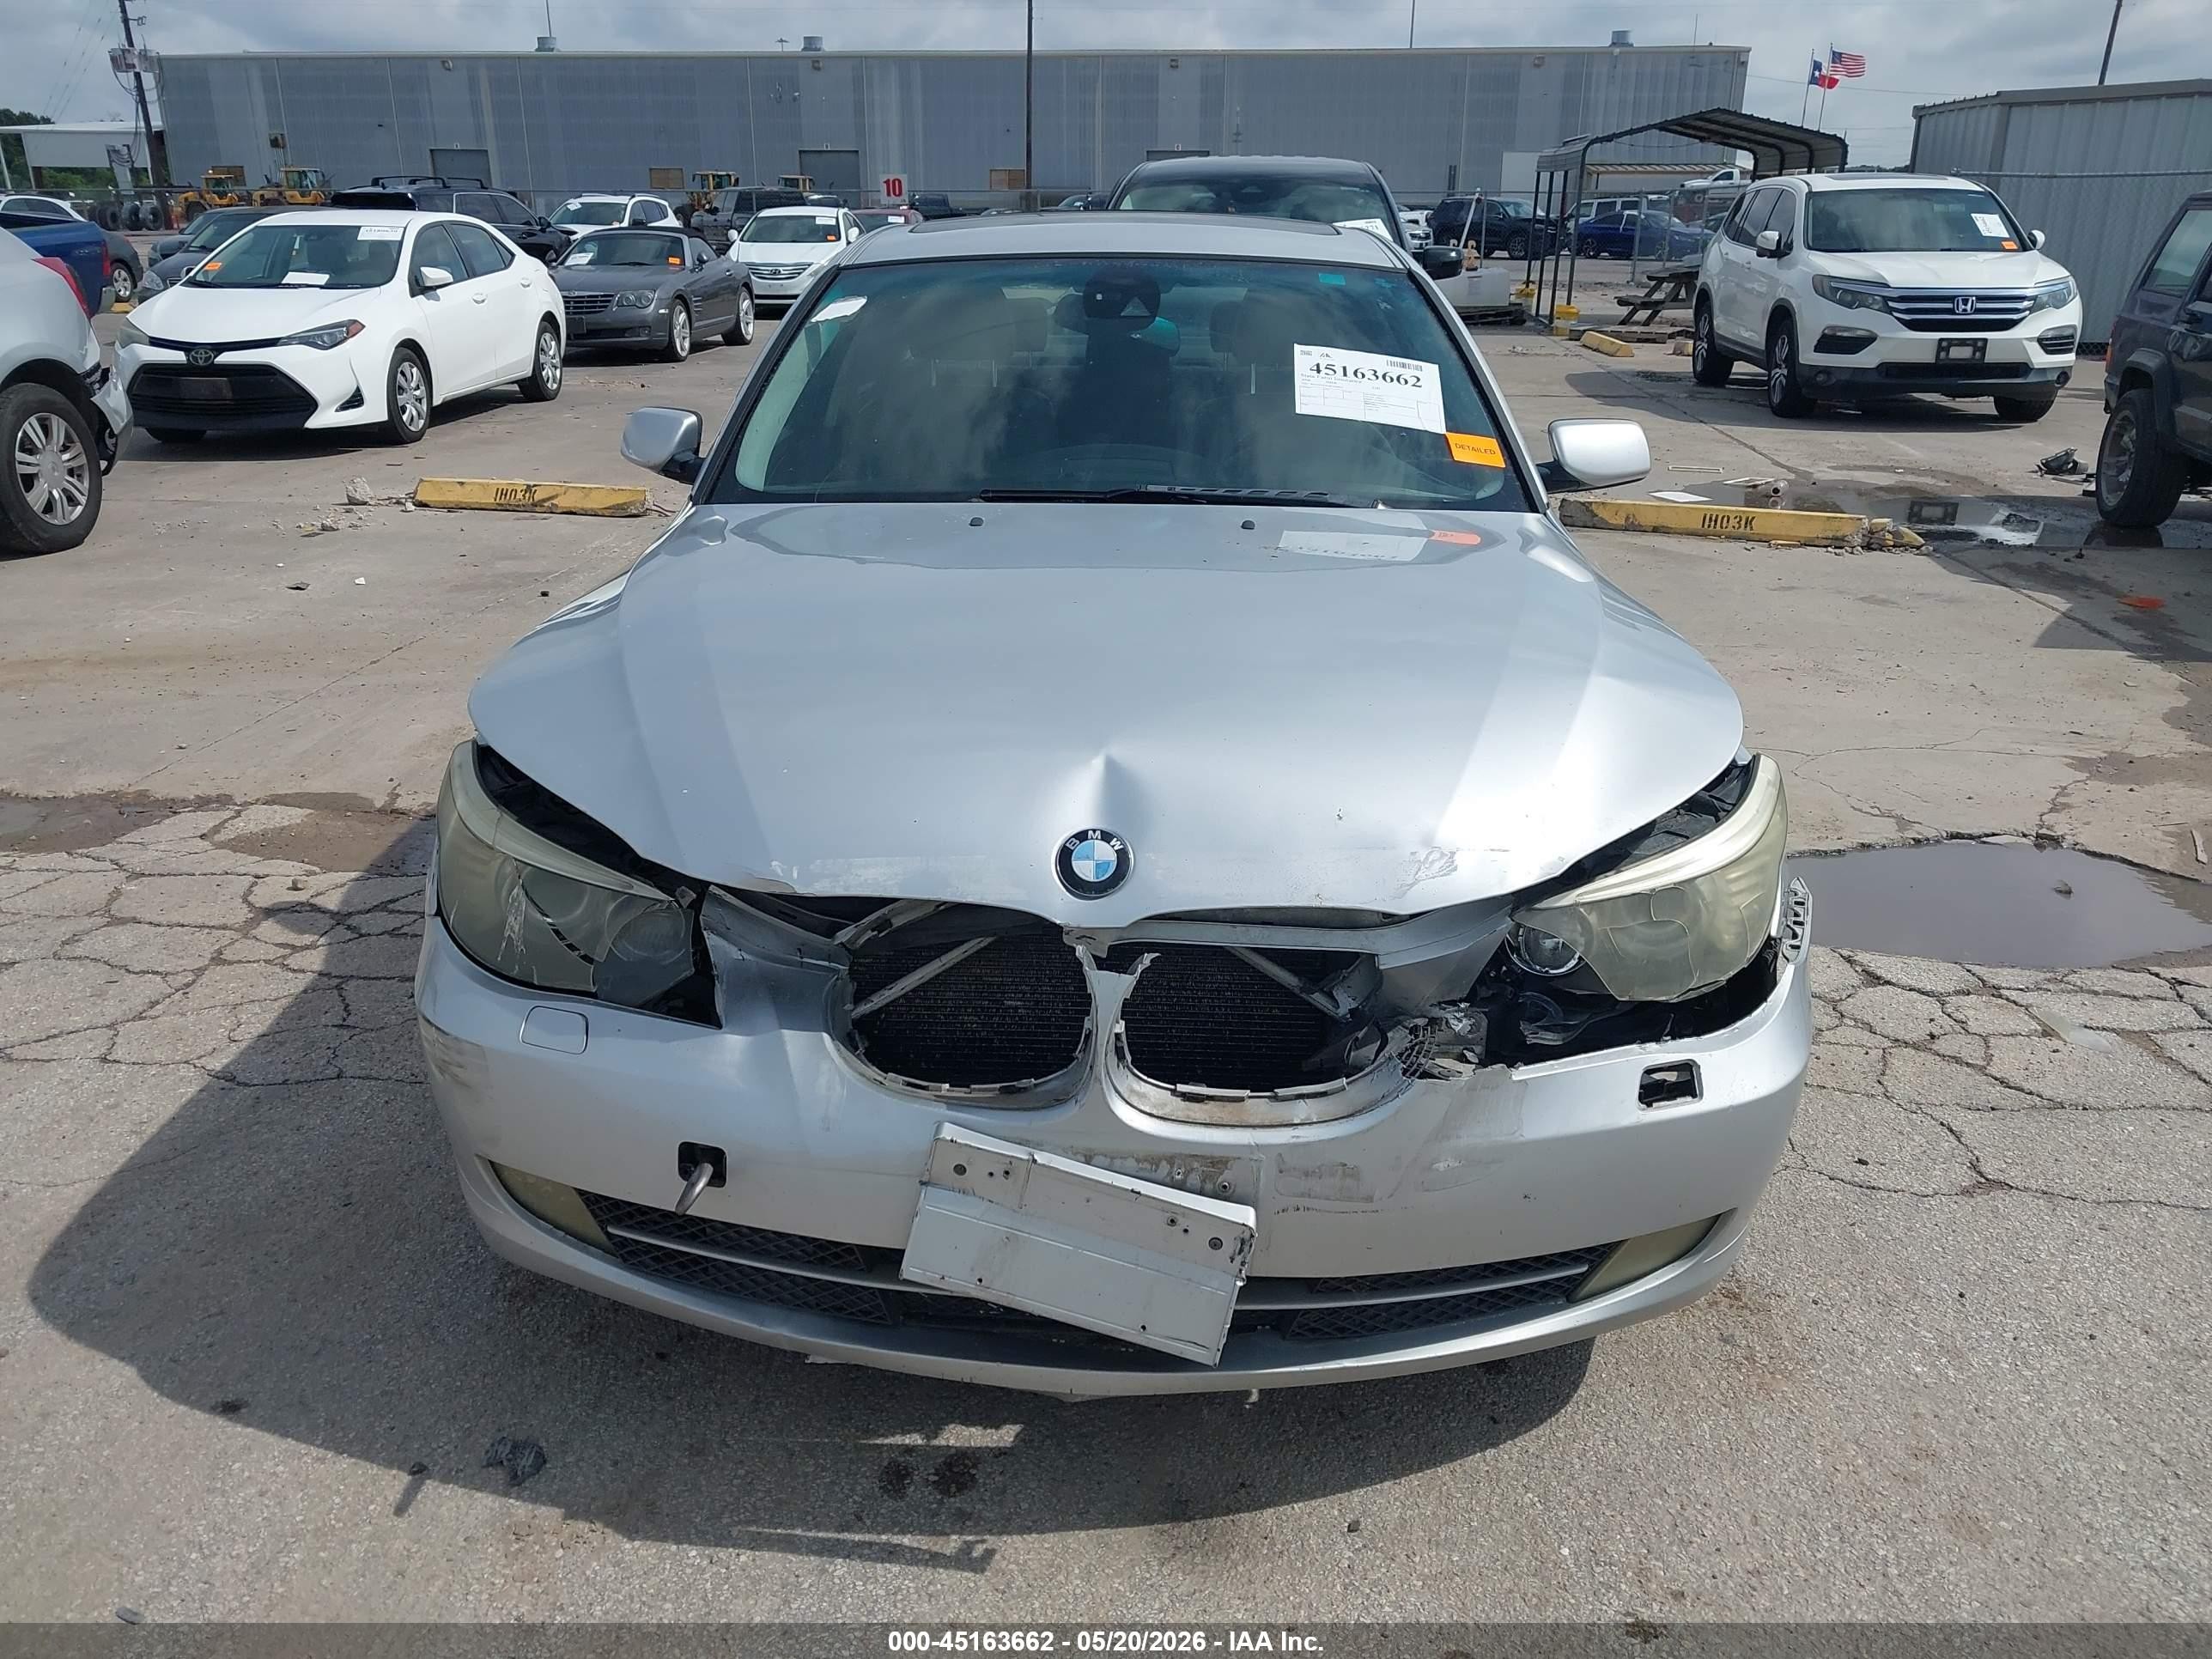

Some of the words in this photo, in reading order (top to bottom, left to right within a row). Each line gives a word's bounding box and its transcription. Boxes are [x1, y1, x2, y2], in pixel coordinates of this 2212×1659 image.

[883, 178, 902, 198] 10
[1310, 362, 1423, 388] 45163662
[1455, 443, 1496, 455] DETAILED
[1065, 830, 1125, 851] BMW
